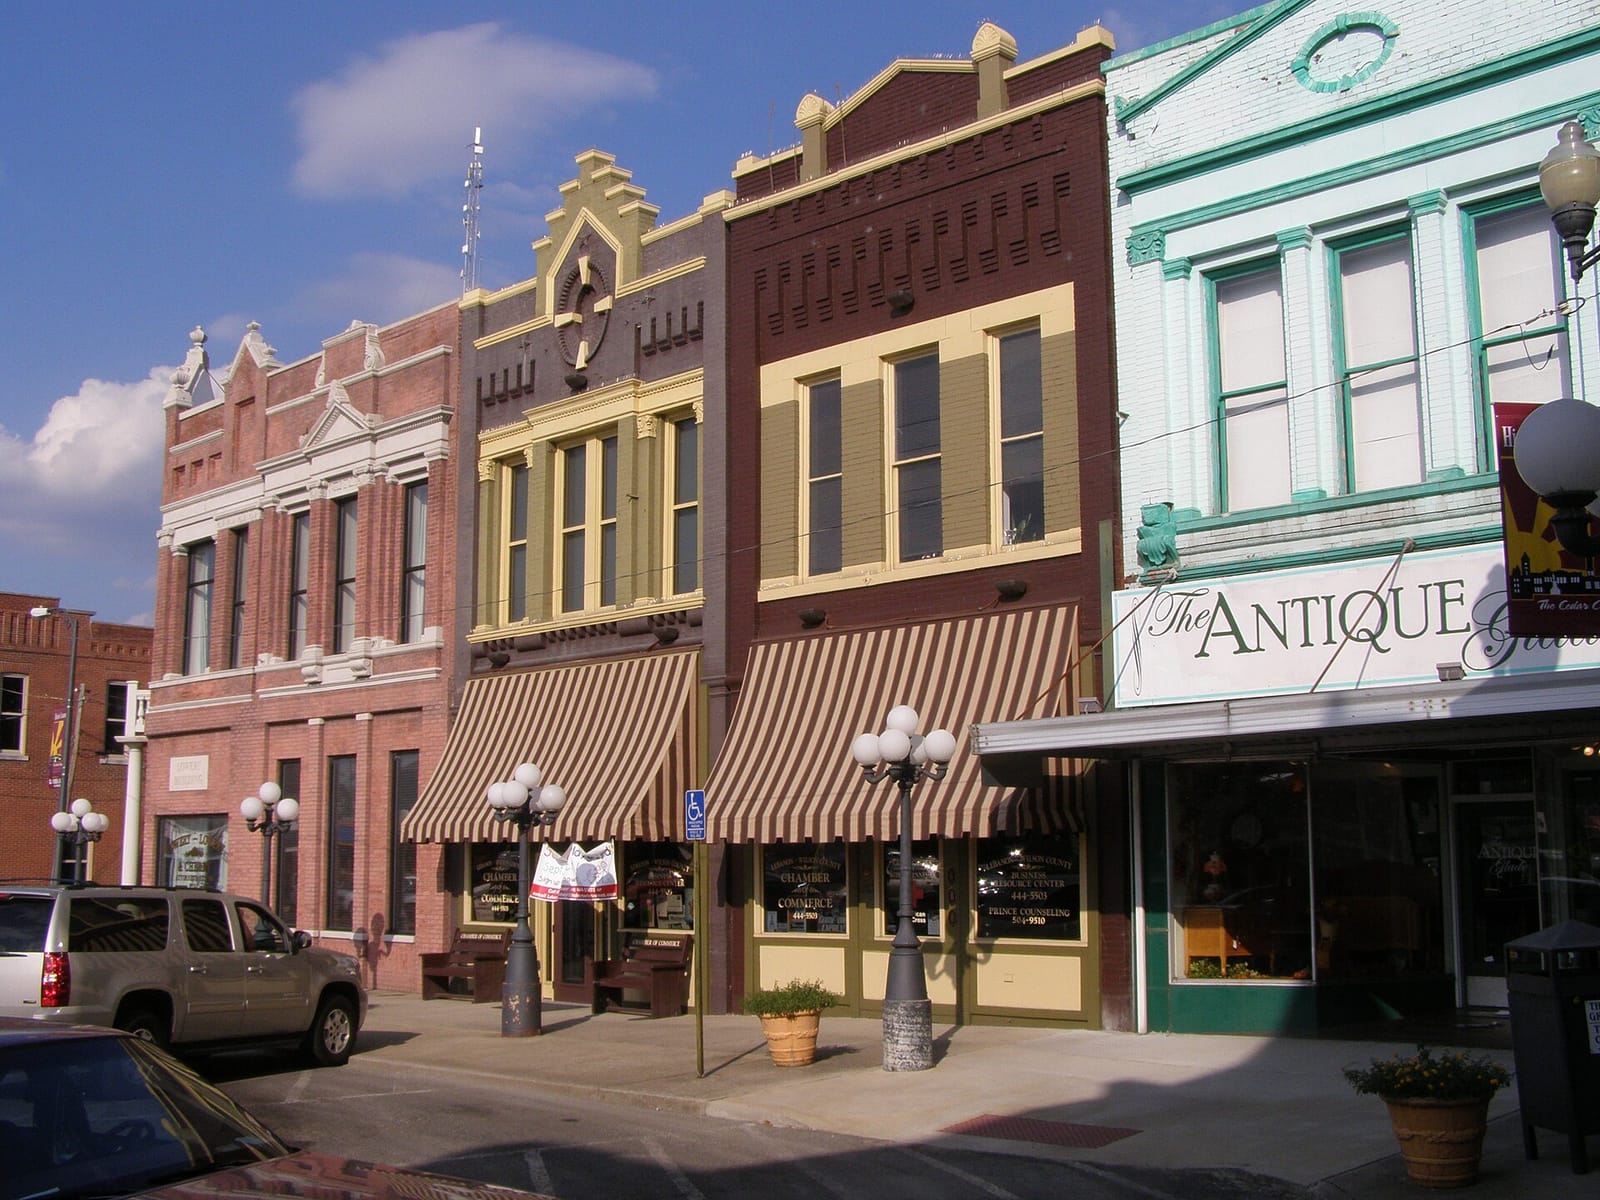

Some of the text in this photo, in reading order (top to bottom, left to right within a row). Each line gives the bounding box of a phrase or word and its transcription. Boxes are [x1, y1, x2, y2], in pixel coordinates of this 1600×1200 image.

[1537, 599, 1555, 610] The
[1148, 587, 1211, 637] The
[1194, 578, 1471, 659] ANTIQUE
[780, 872, 830, 883] CHAMBER
[1011, 871, 1047, 879] BUSINESS
[1034, 880, 1065, 888] CENTER
[1011, 891, 1048, 900] 444-5503
[778, 897, 833, 909] COMMERCE
[989, 906, 1071, 917] PRINCE COUNSELING
